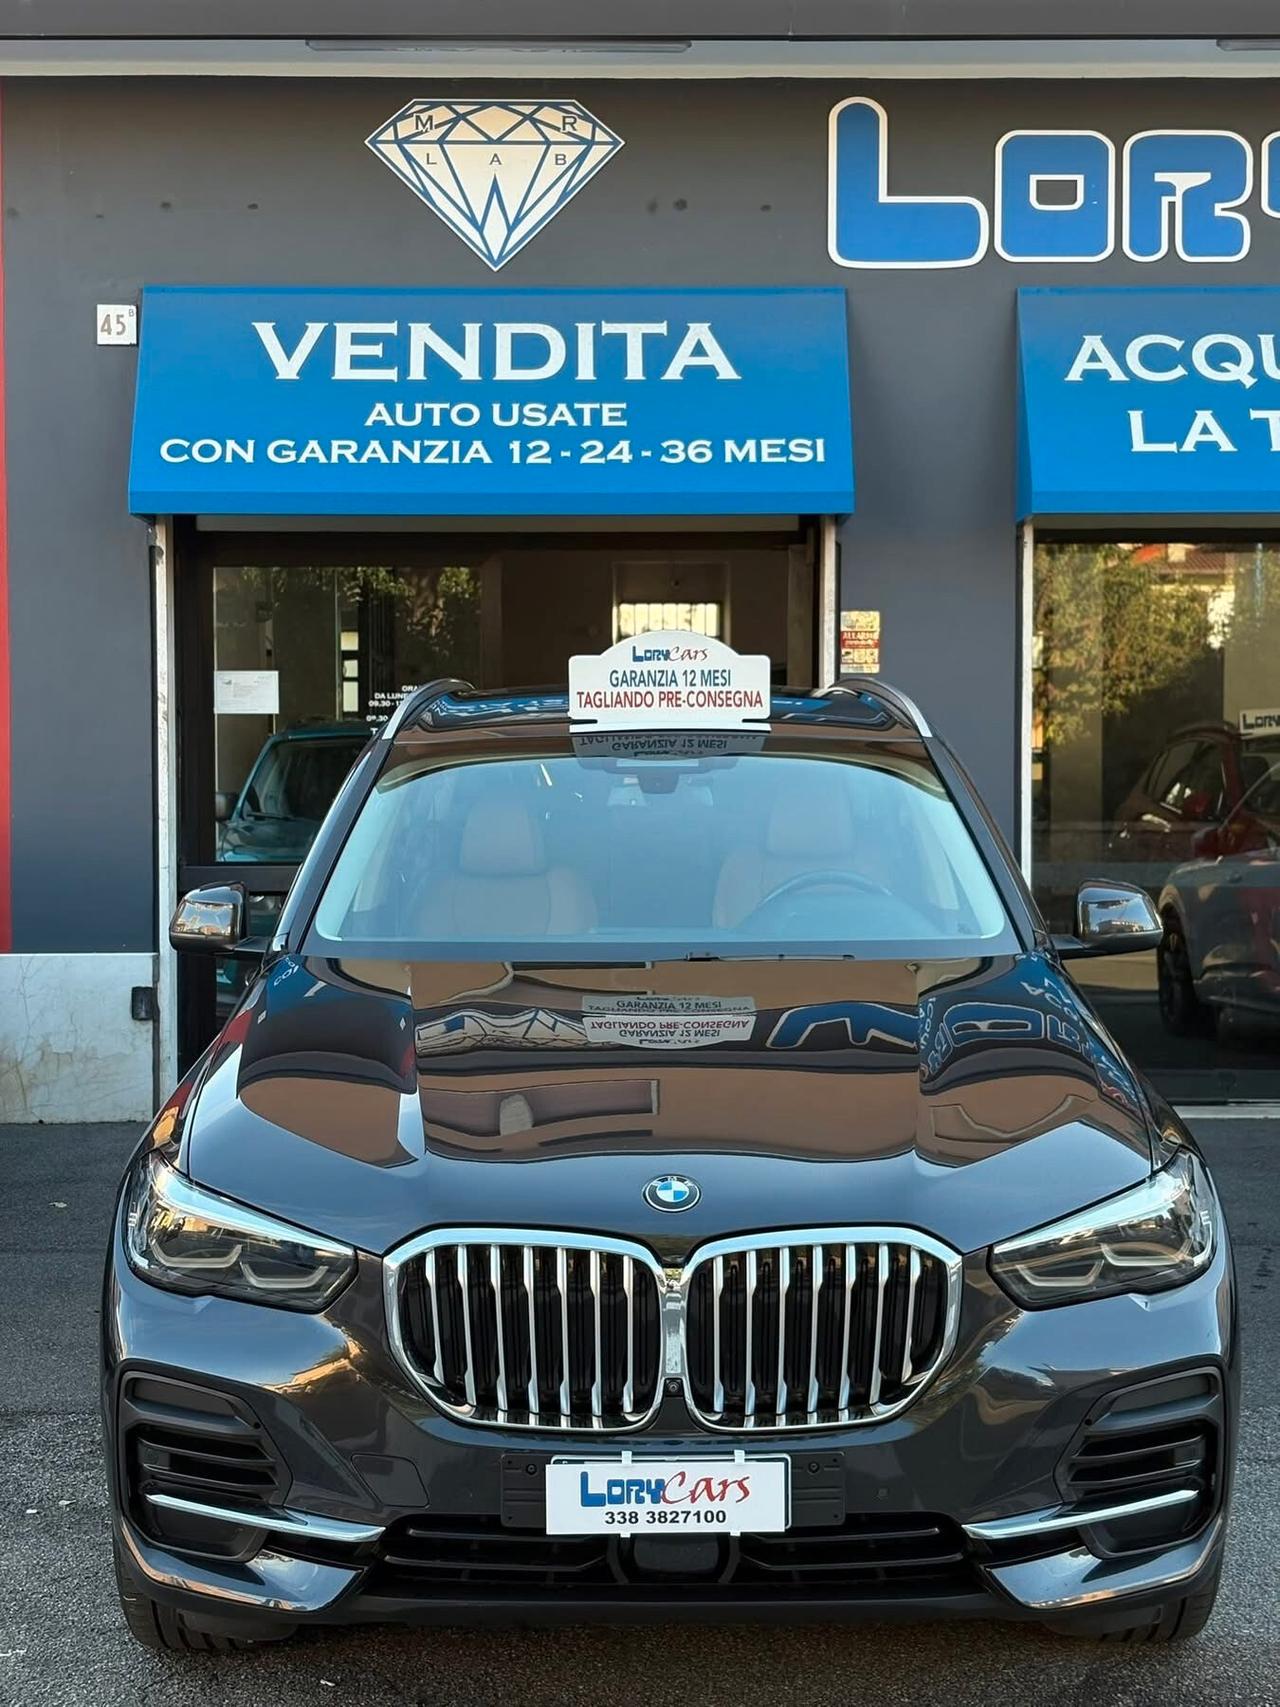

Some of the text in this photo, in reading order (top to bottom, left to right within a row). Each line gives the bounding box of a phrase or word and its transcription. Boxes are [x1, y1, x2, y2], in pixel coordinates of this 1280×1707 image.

[415, 115, 578, 132] M R
[251, 320, 742, 382] VENDITA
[364, 402, 628, 427] AUTO USATE
[1127, 408, 1238, 454] LA
[159, 438, 256, 464] CON
[266, 439, 493, 464] GARANZIA
[508, 440, 553, 464] 12
[580, 440, 634, 465] 24
[659, 439, 714, 464] 36
[724, 438, 827, 464] MESI
[609, 669, 732, 688] GARANZIA 12 MESI
[577, 691, 654, 709] TAGLIANDO
[658, 690, 764, 708] PRE-CONSEGNA
[604, 1510, 727, 1525] 338 3827100
